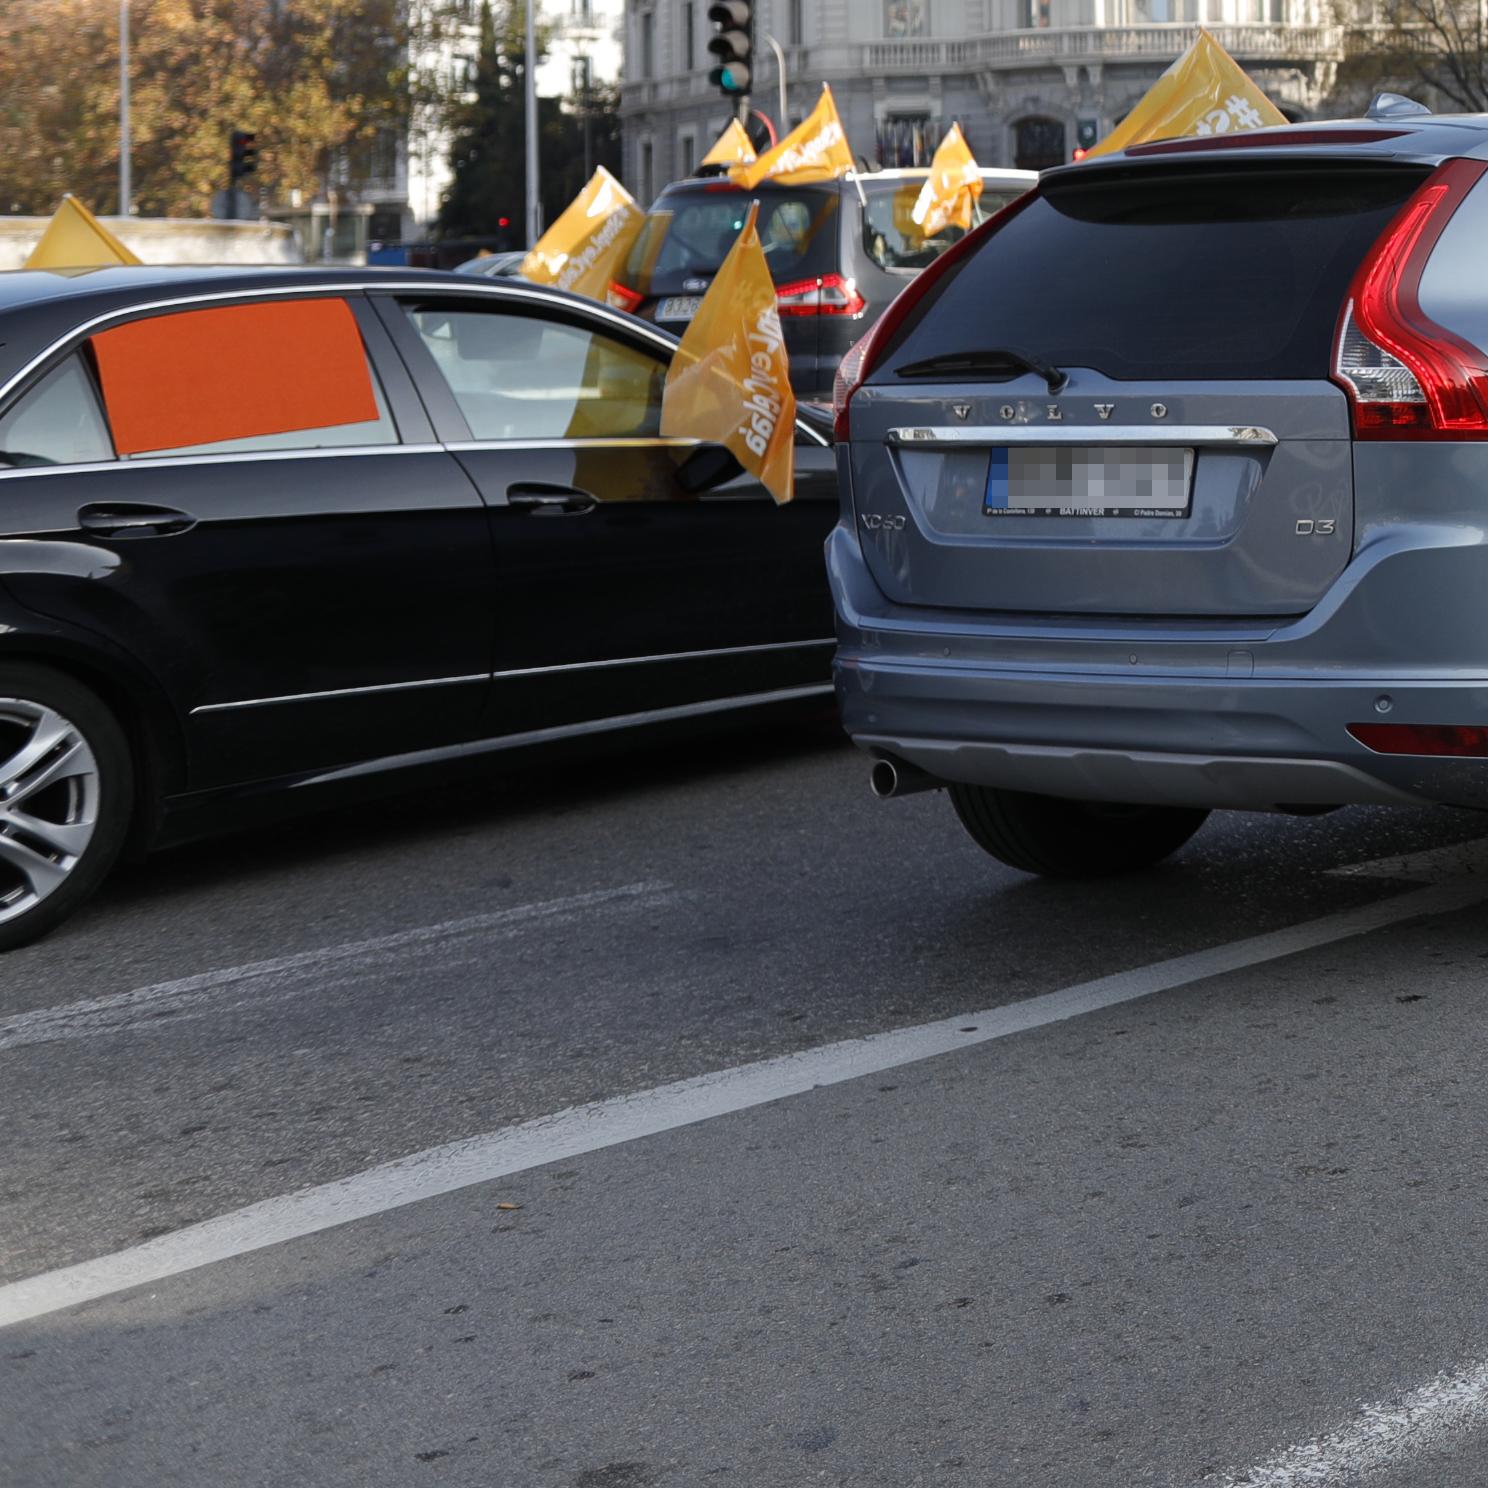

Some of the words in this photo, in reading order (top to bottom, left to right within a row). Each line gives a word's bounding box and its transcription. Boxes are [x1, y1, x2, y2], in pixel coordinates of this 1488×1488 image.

[953, 402, 1167, 420] VOLVO
[861, 513, 906, 530] XC60
[1296, 519, 1336, 534] D3
